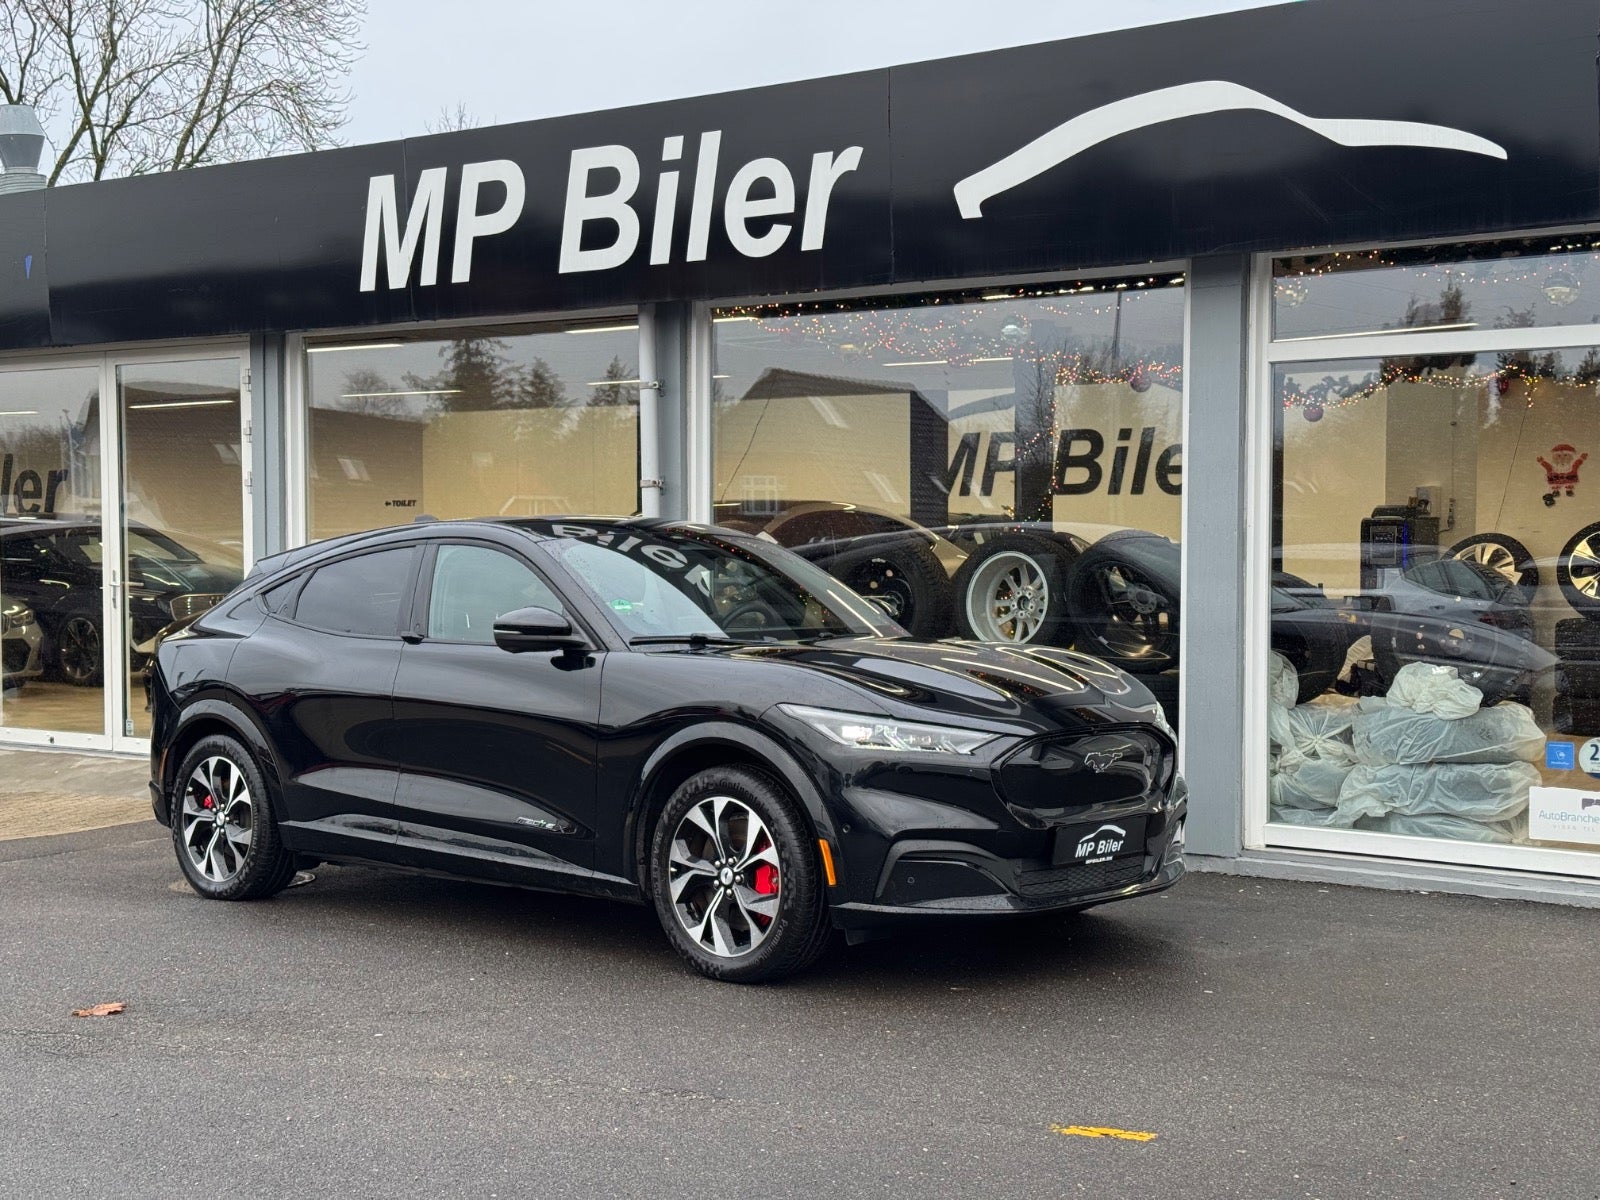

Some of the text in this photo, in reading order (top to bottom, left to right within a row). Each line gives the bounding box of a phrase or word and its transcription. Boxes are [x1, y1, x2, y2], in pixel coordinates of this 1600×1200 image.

[360, 130, 864, 292] MP Biler
[1075, 838, 1124, 858] MP Biler
